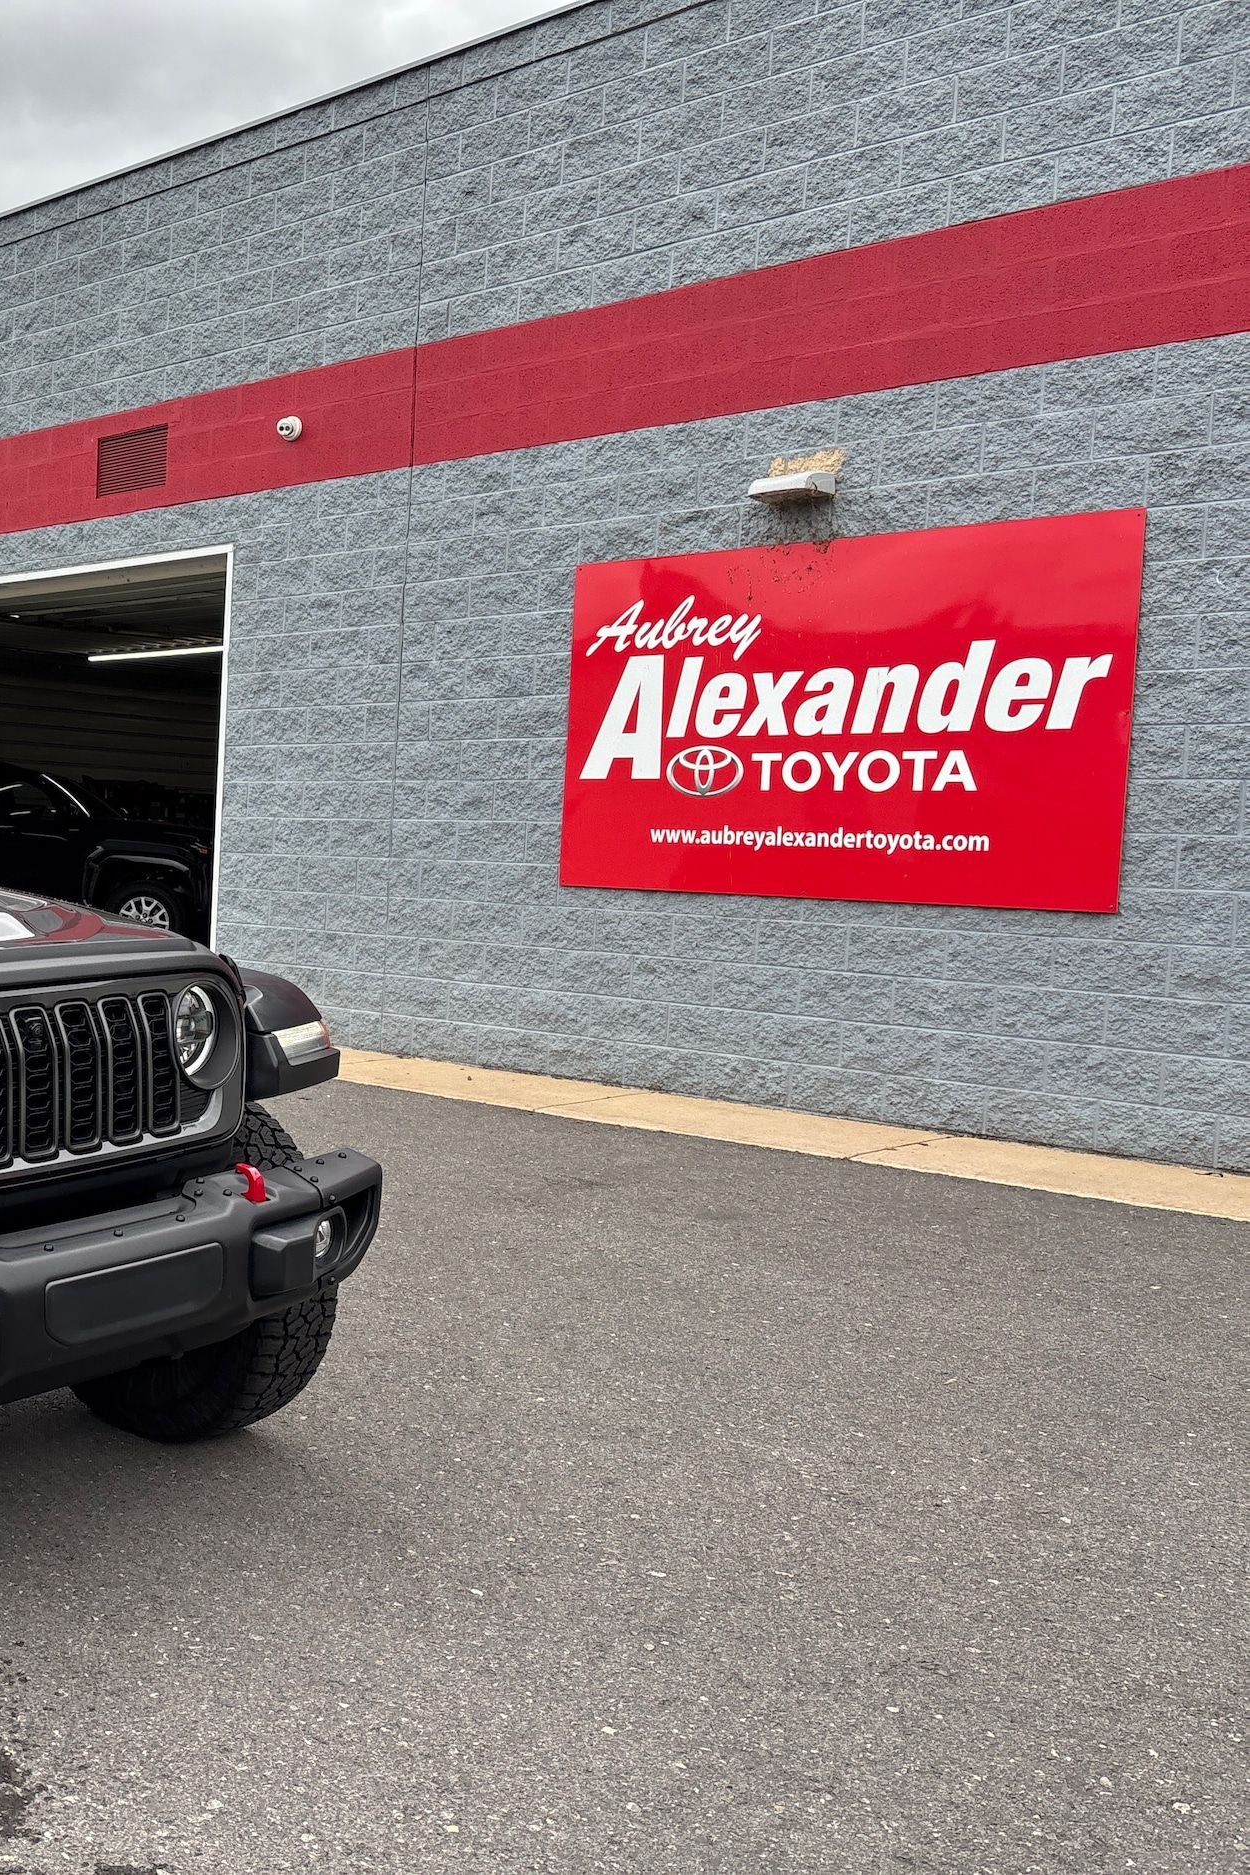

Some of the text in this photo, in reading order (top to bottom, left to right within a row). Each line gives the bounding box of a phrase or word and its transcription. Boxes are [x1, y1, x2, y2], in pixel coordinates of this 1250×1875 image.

[586, 595, 762, 661] Aubrey
[580, 640, 1114, 780] Alexander
[751, 750, 978, 793] TOYOTA
[650, 825, 990, 856] www.aubreyalexandertoyota.com
